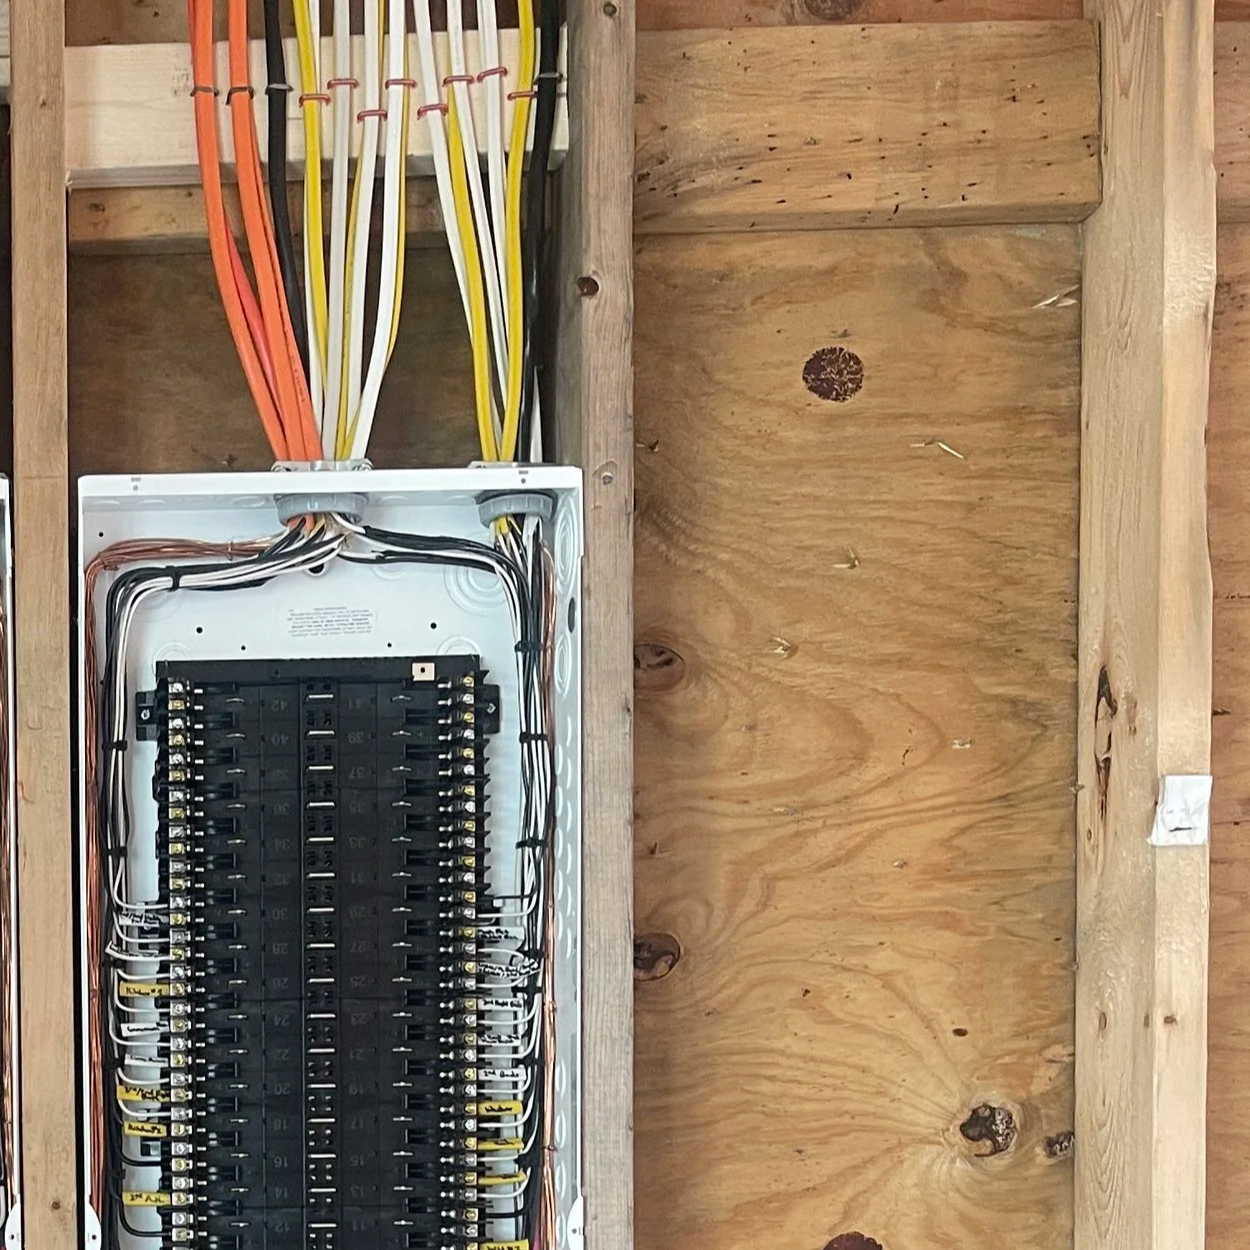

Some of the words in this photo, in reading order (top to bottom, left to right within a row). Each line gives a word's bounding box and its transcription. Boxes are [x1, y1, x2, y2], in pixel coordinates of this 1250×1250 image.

[270, 699, 289, 712] 42
[271, 733, 289, 746] 40
[271, 908, 288, 921] 30
[273, 1014, 290, 1027] 24
[350, 1012, 367, 1025] 23
